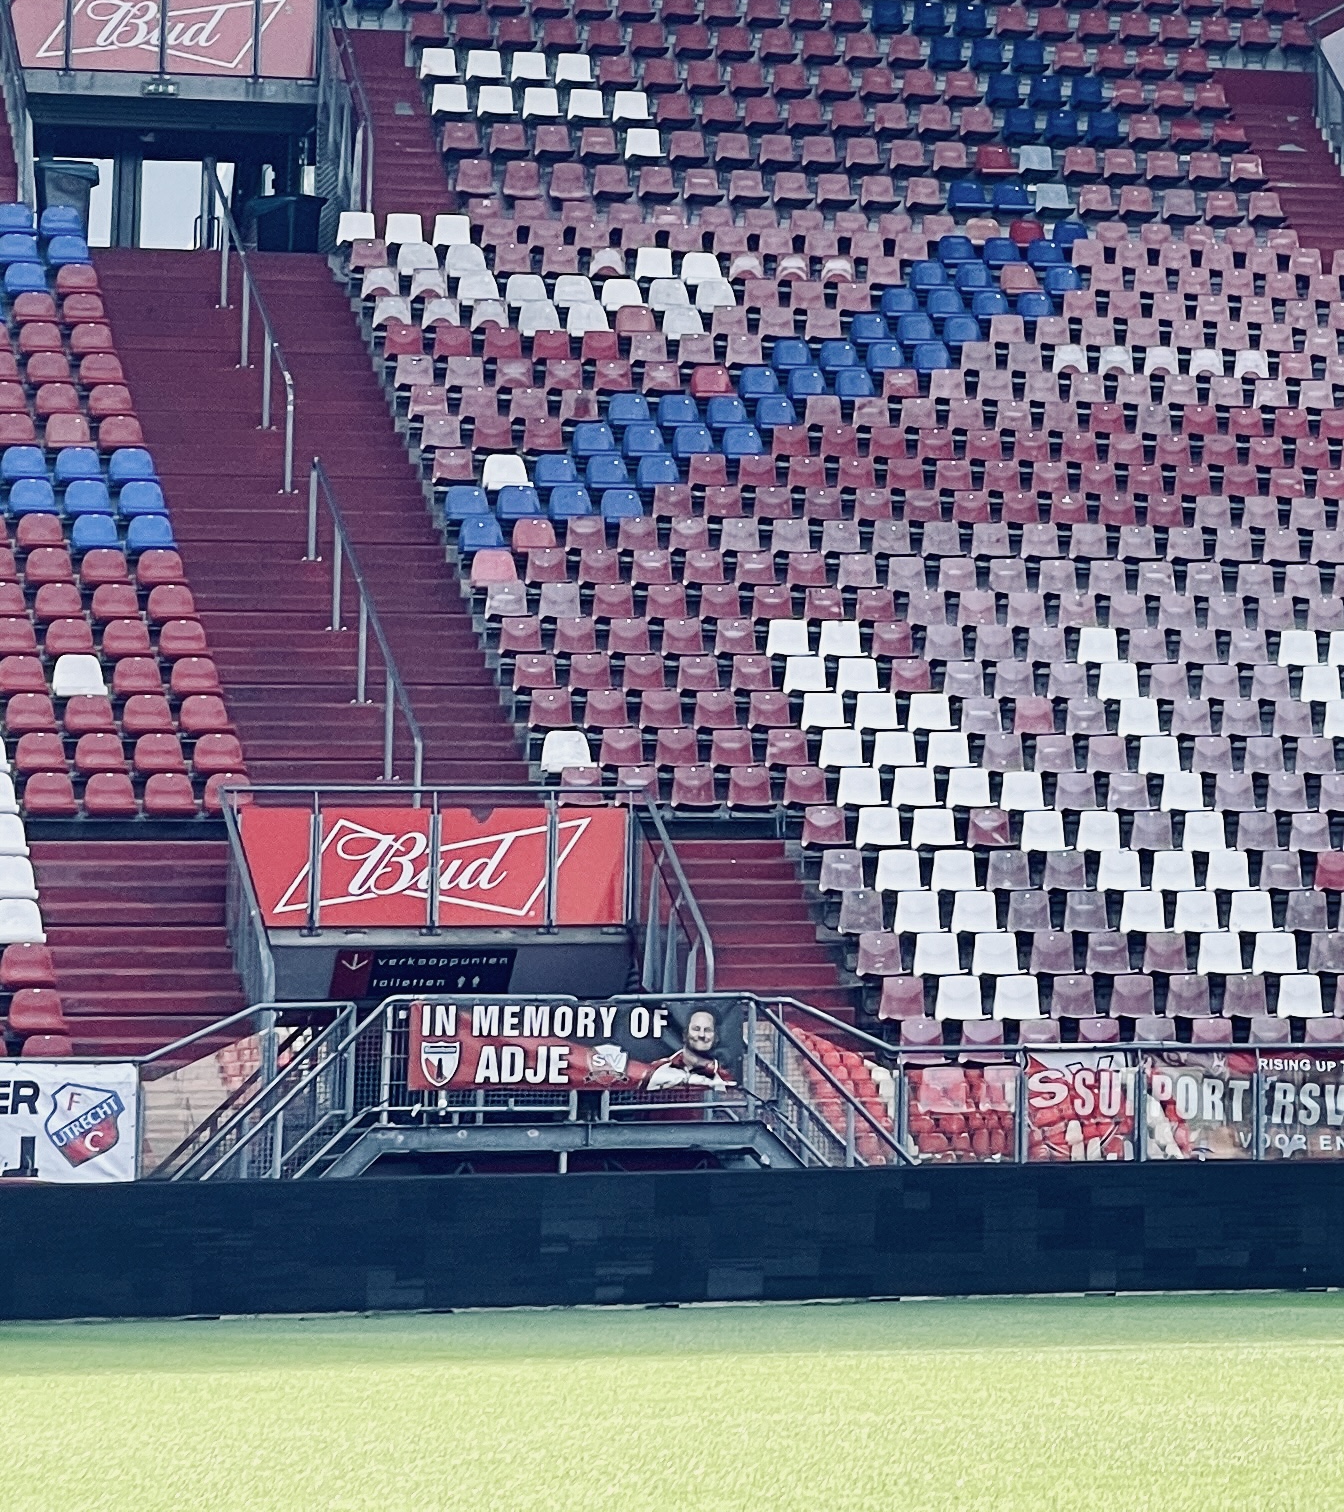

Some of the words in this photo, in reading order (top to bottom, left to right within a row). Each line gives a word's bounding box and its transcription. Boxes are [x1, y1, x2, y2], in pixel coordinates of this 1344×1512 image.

[87, 0, 228, 48] Bud
[337, 832, 516, 896] Bud
[421, 1005, 457, 1037] IN
[472, 1005, 617, 1038] MEMORY
[629, 1006, 668, 1039] OF
[474, 1045, 570, 1084] ADJE
[1258, 1058, 1311, 1071] RISING
[1315, 1060, 1337, 1073] UP
[53, 1098, 119, 1147] UTRECHT
[84, 1130, 104, 1152] C
